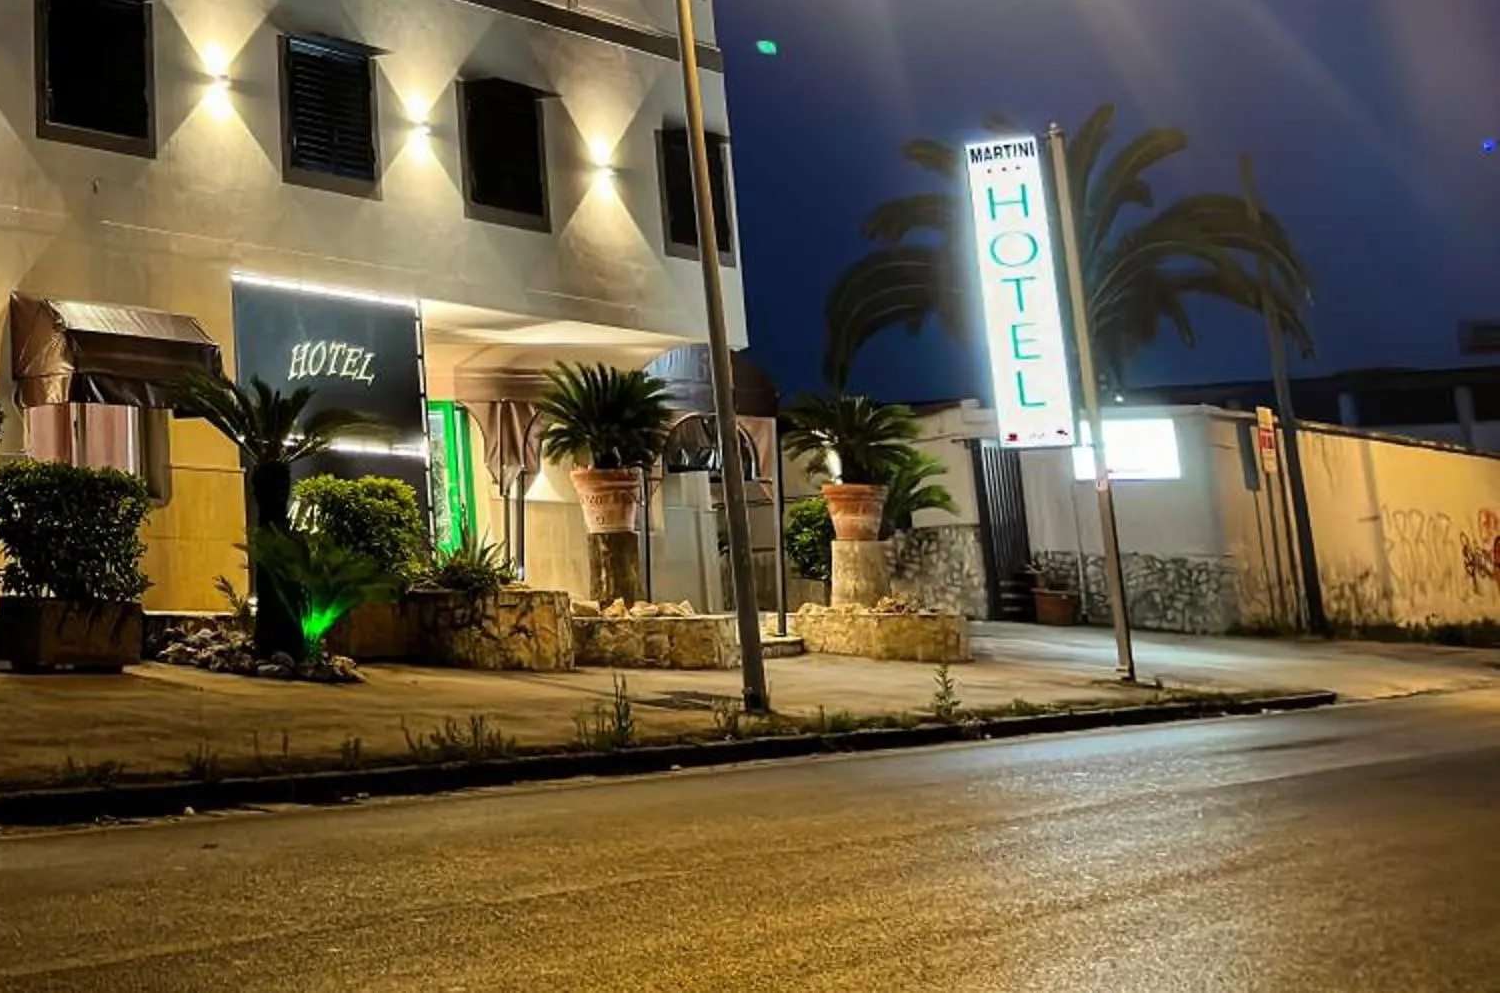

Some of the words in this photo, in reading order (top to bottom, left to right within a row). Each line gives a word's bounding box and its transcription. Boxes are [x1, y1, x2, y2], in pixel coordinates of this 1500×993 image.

[969, 140, 1035, 164] MARTINI
[987, 182, 1045, 408] HOTEL
[287, 340, 376, 387] HOTEL
